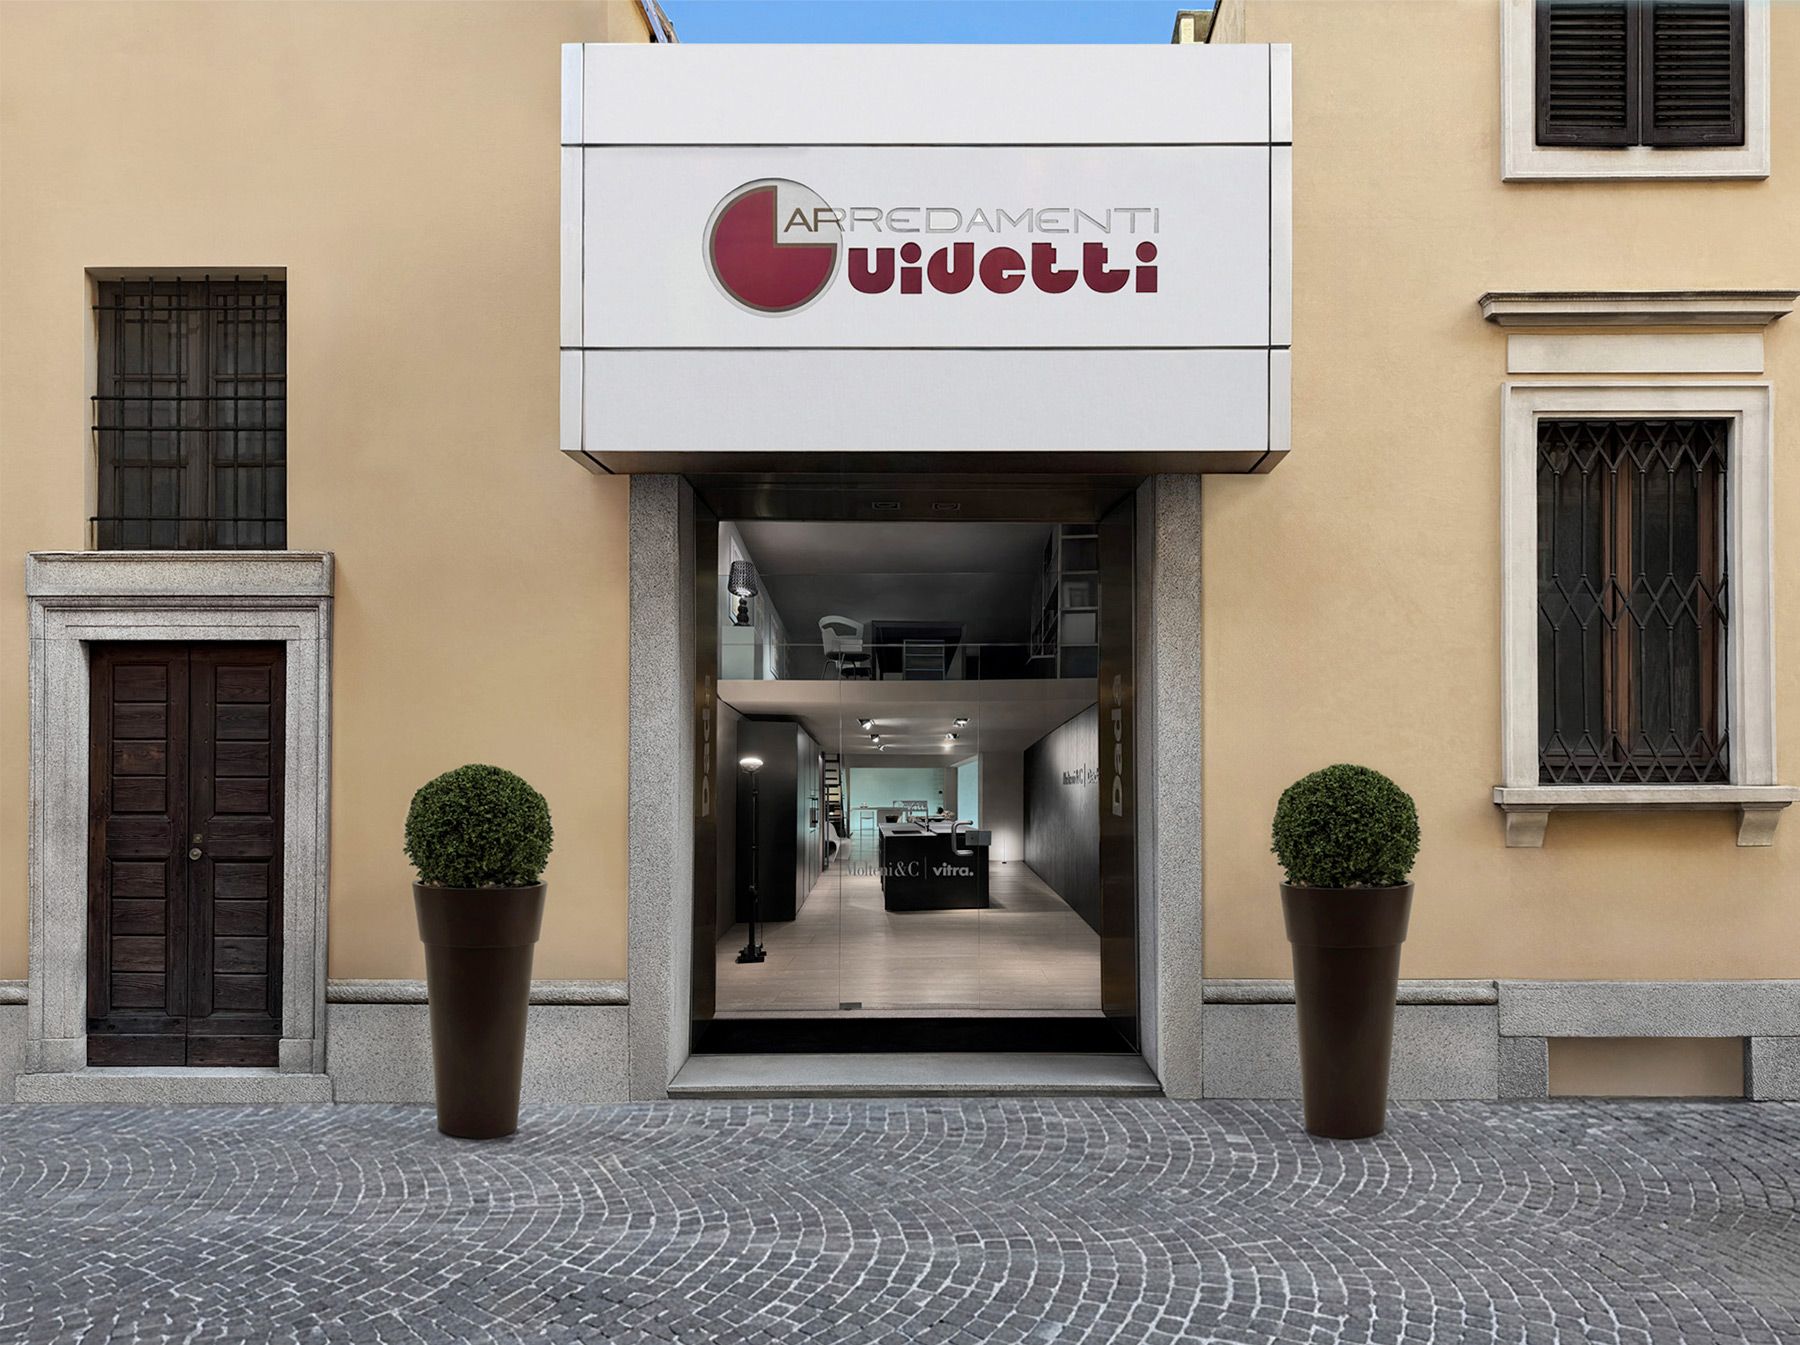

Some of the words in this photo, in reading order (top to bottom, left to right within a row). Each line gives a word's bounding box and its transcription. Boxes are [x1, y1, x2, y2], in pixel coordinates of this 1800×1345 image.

[783, 206, 1160, 234] ARREDAMENTI
[1111, 674, 1123, 817] Dada
[847, 860, 920, 878] Molteni&C
[932, 861, 974, 877] vitra.
